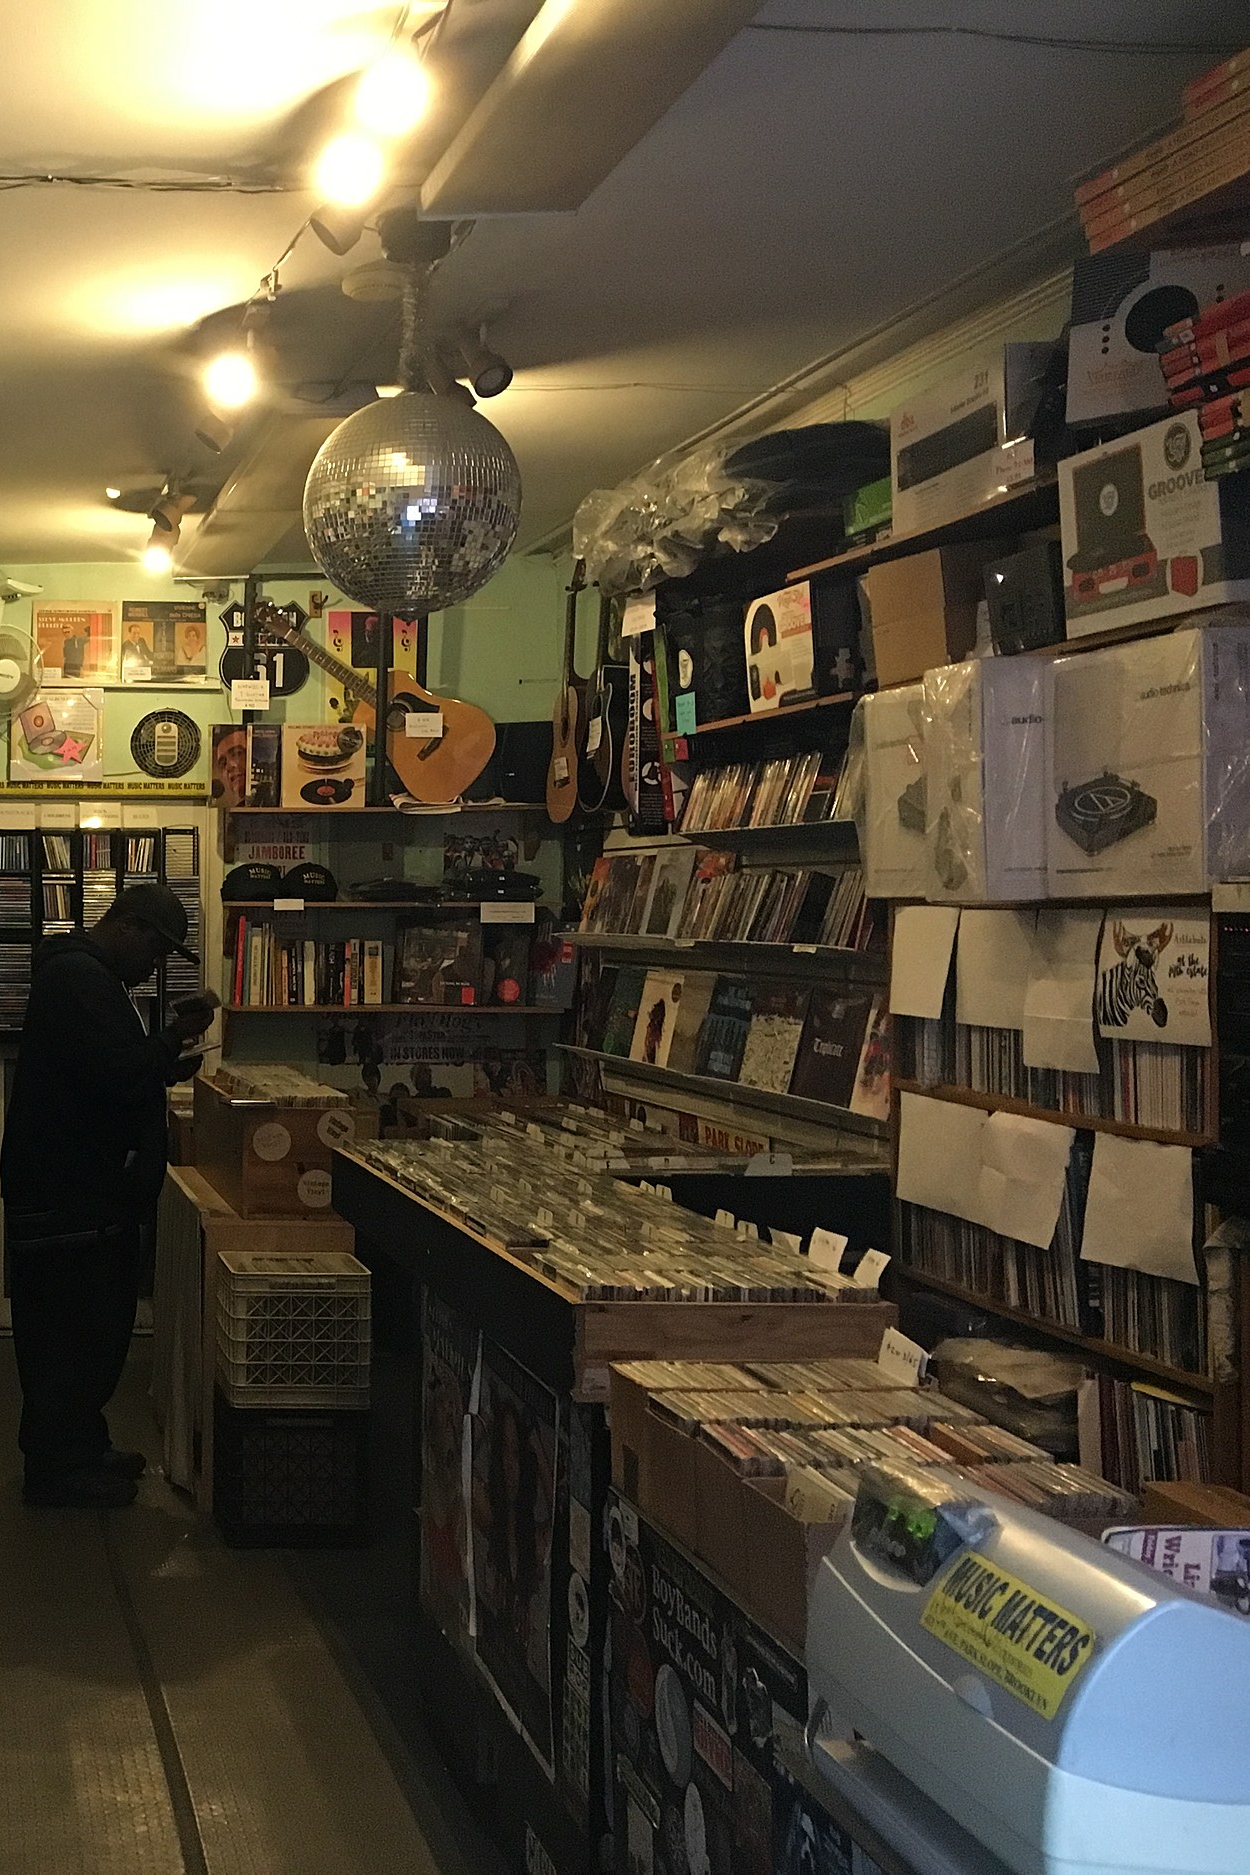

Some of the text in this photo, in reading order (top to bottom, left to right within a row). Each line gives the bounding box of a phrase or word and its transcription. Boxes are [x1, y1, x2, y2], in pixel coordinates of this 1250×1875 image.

[22, 781, 44, 789] MATTERS
[62, 781, 84, 789] MATTERS
[103, 781, 125, 789] MATTERS
[127, 781, 165, 789] MUSIC MATTERS
[168, 782, 206, 790] MUSIC MATTERS
[248, 845, 306, 860] JAMBOREE
[302, 871, 326, 881] MUSIC
[650, 1564, 718, 1660] BoyBands
[941, 1556, 1010, 1620] MUSIC
[990, 1589, 1090, 1677] MATTERS
[651, 1615, 718, 1705] Suck.com
